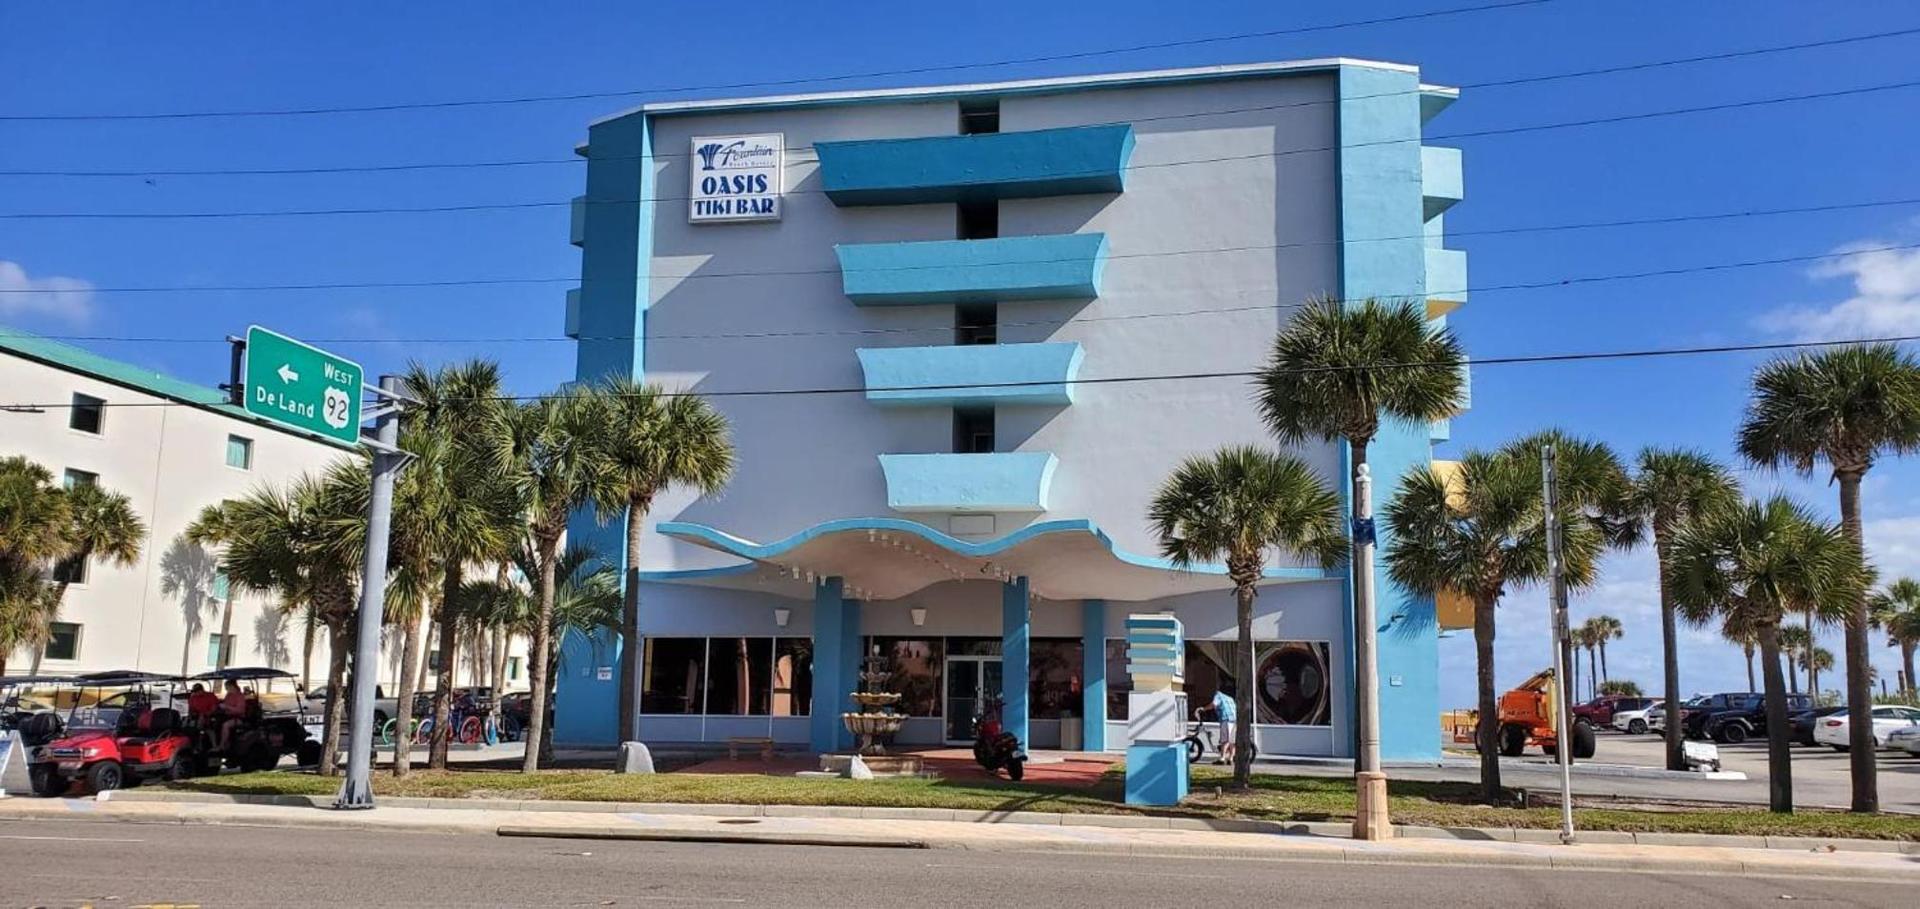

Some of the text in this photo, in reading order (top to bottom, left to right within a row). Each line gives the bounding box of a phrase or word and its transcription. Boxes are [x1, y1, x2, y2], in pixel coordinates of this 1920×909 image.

[719, 140, 772, 167] Fountain
[702, 173, 767, 195] OASIS
[695, 198, 774, 216] TIKI BAR
[324, 362, 353, 386] WEST
[327, 396, 347, 421] 92
